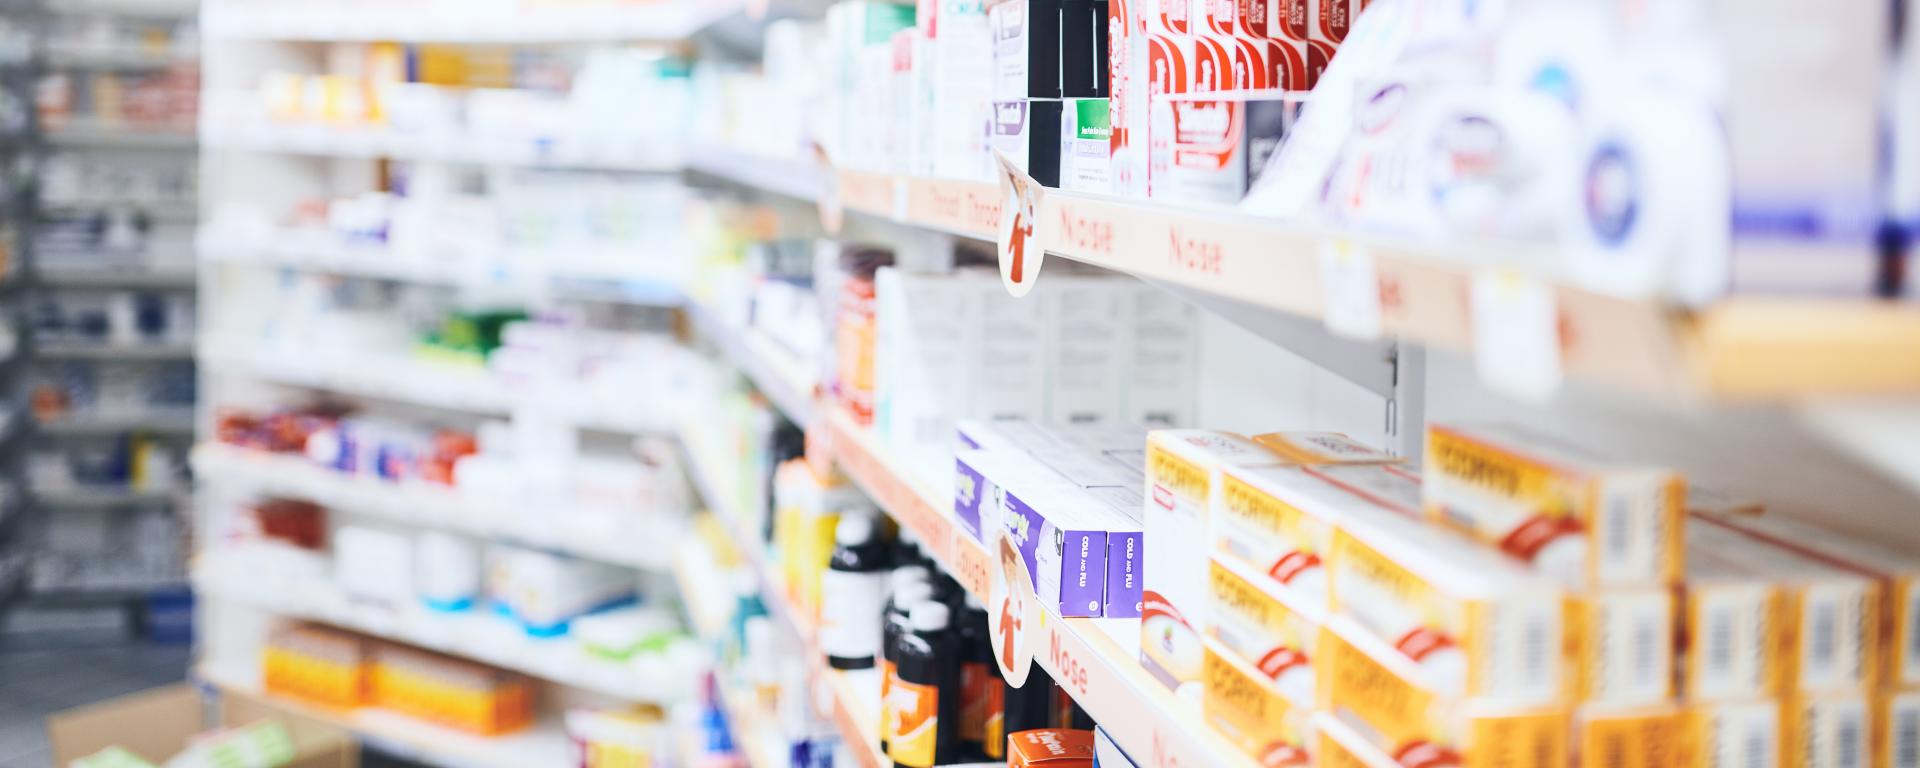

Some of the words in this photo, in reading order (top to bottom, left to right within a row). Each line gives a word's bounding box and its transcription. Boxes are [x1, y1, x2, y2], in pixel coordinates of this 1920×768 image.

[1060, 205, 1114, 252] Nose
[1168, 225, 1225, 275] Nose
[1081, 536, 1089, 558] COLD
[1126, 537, 1134, 559] COLD
[1079, 572, 1087, 587] FLU
[1125, 573, 1133, 588] FLU
[1051, 628, 1088, 695] Nose
